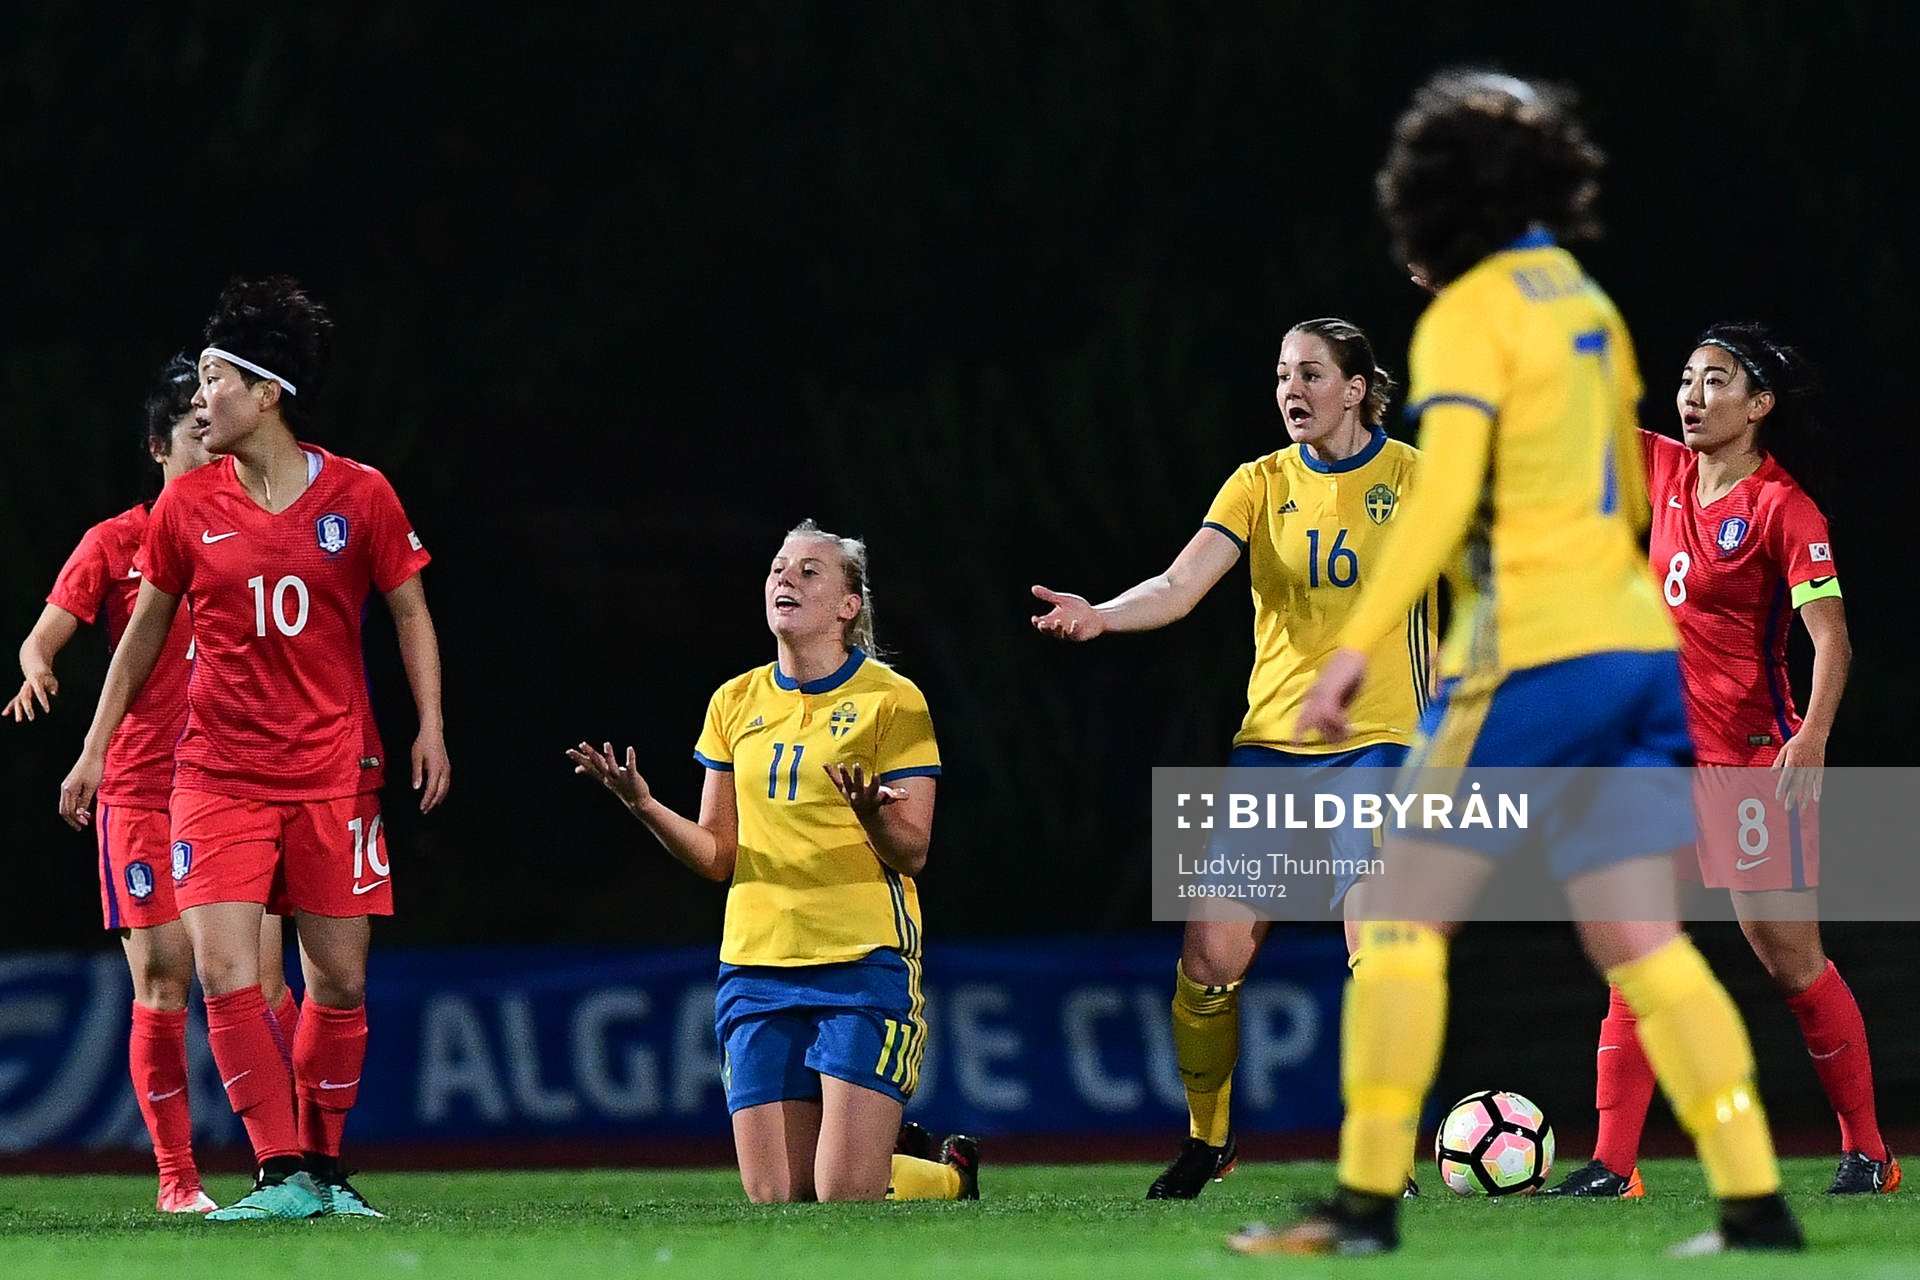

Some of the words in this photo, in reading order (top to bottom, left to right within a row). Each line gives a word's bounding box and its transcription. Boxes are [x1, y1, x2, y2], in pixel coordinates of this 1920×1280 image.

[1306, 528, 1359, 589] 16
[1663, 550, 1691, 607] 8
[246, 575, 310, 637] 10
[768, 742, 805, 801] 11
[347, 814, 390, 878] 10
[1737, 798, 1769, 856] 8
[876, 1018, 911, 1082] 11
